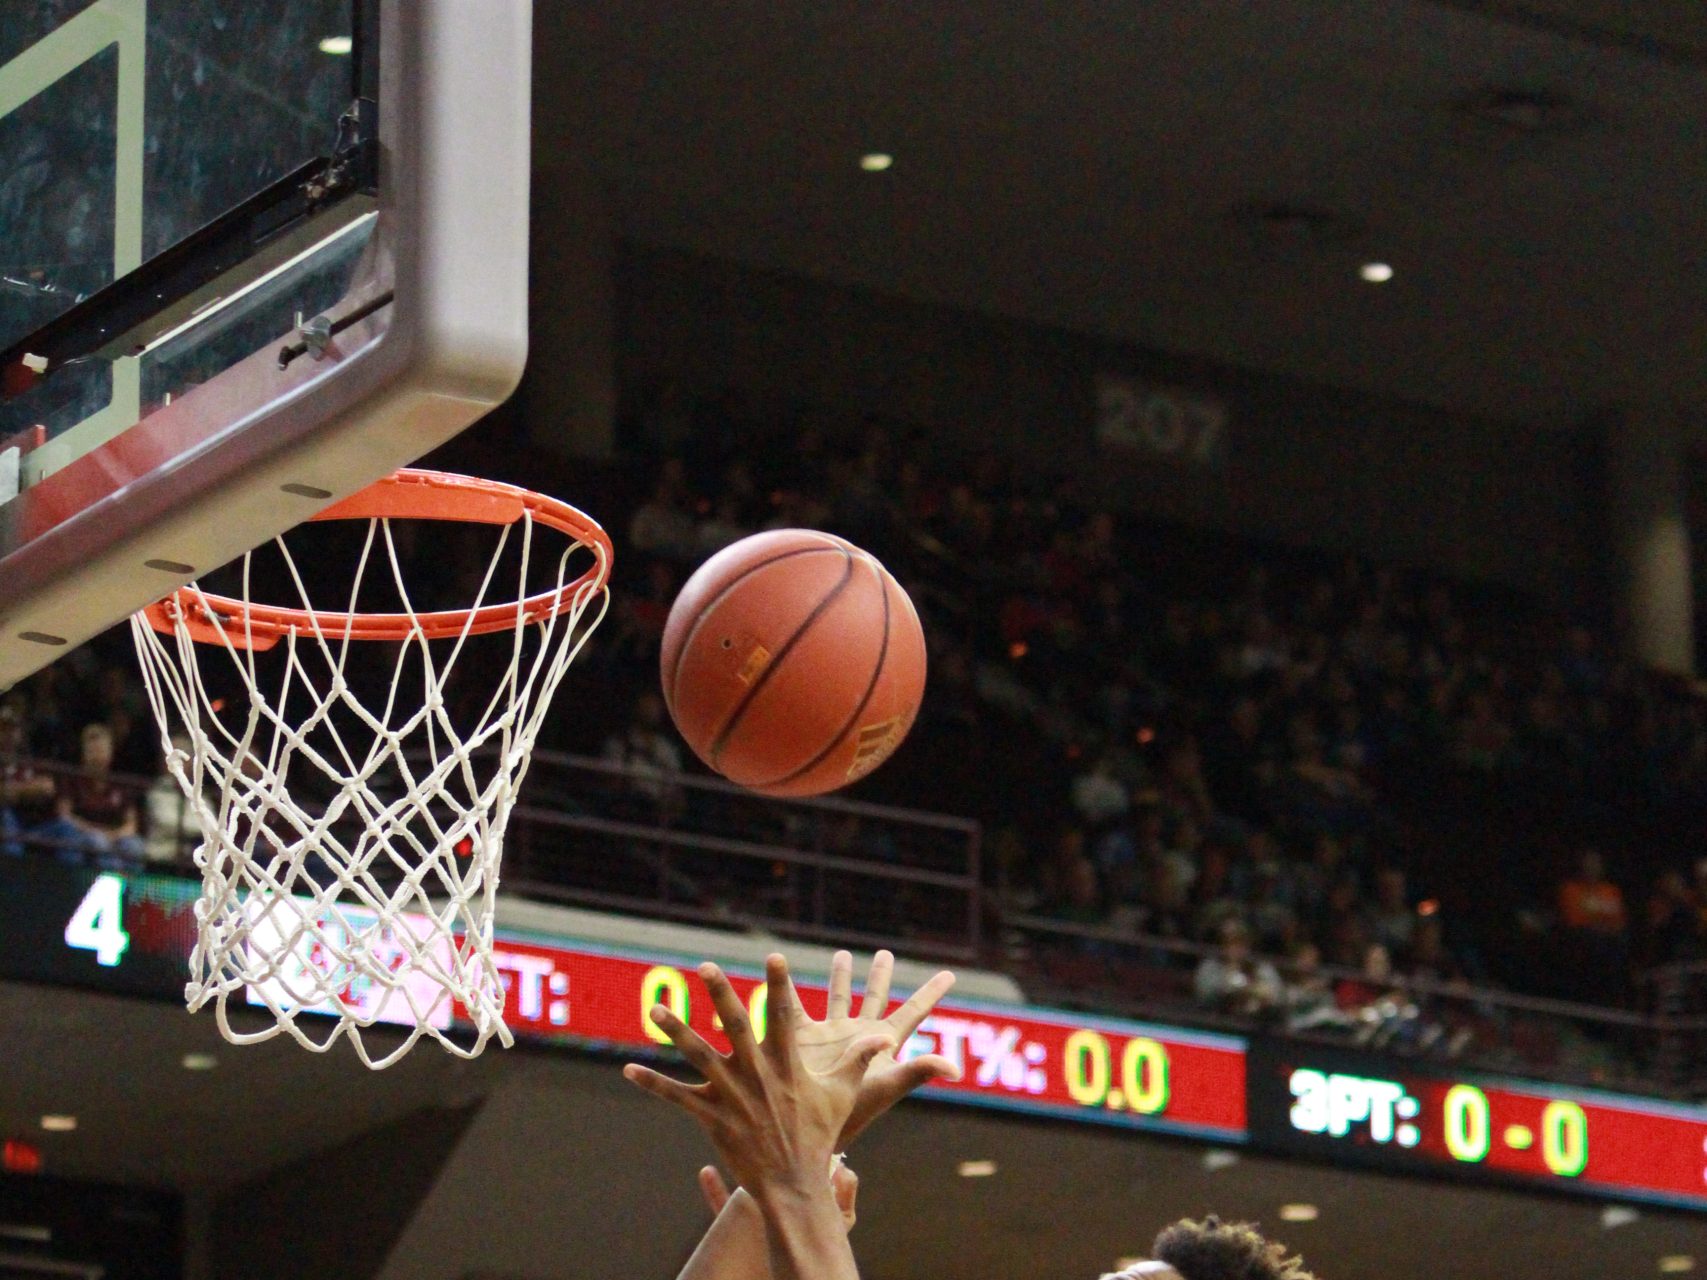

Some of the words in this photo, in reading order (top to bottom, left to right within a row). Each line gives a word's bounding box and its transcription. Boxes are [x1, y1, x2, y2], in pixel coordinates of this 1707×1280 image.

[65, 875, 130, 967] 4
[1065, 1029, 1170, 1115] 0.0
[1290, 1069, 1420, 1147] 3PT:
